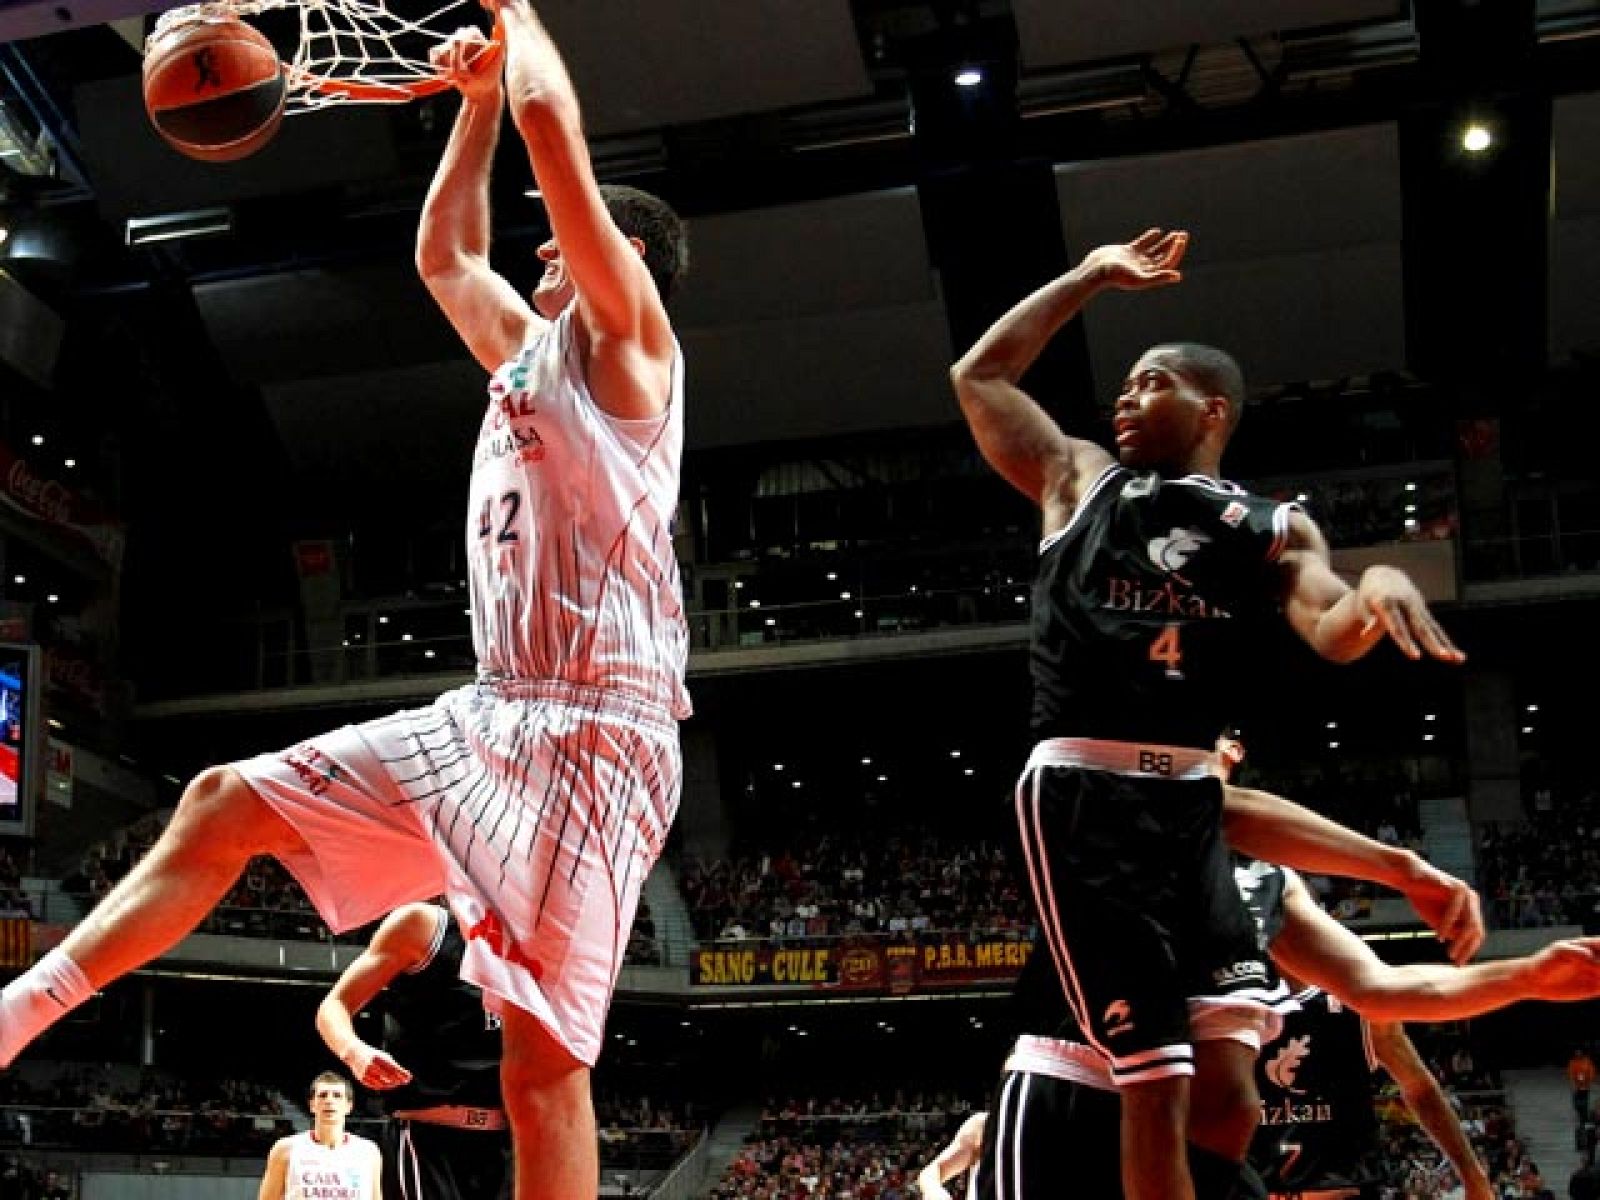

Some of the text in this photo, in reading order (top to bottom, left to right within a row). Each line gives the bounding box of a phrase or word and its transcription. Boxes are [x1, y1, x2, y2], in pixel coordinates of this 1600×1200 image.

[1148, 623, 1184, 680] 4
[699, 950, 755, 984] SANG
[1279, 1141, 1303, 1180] 7
